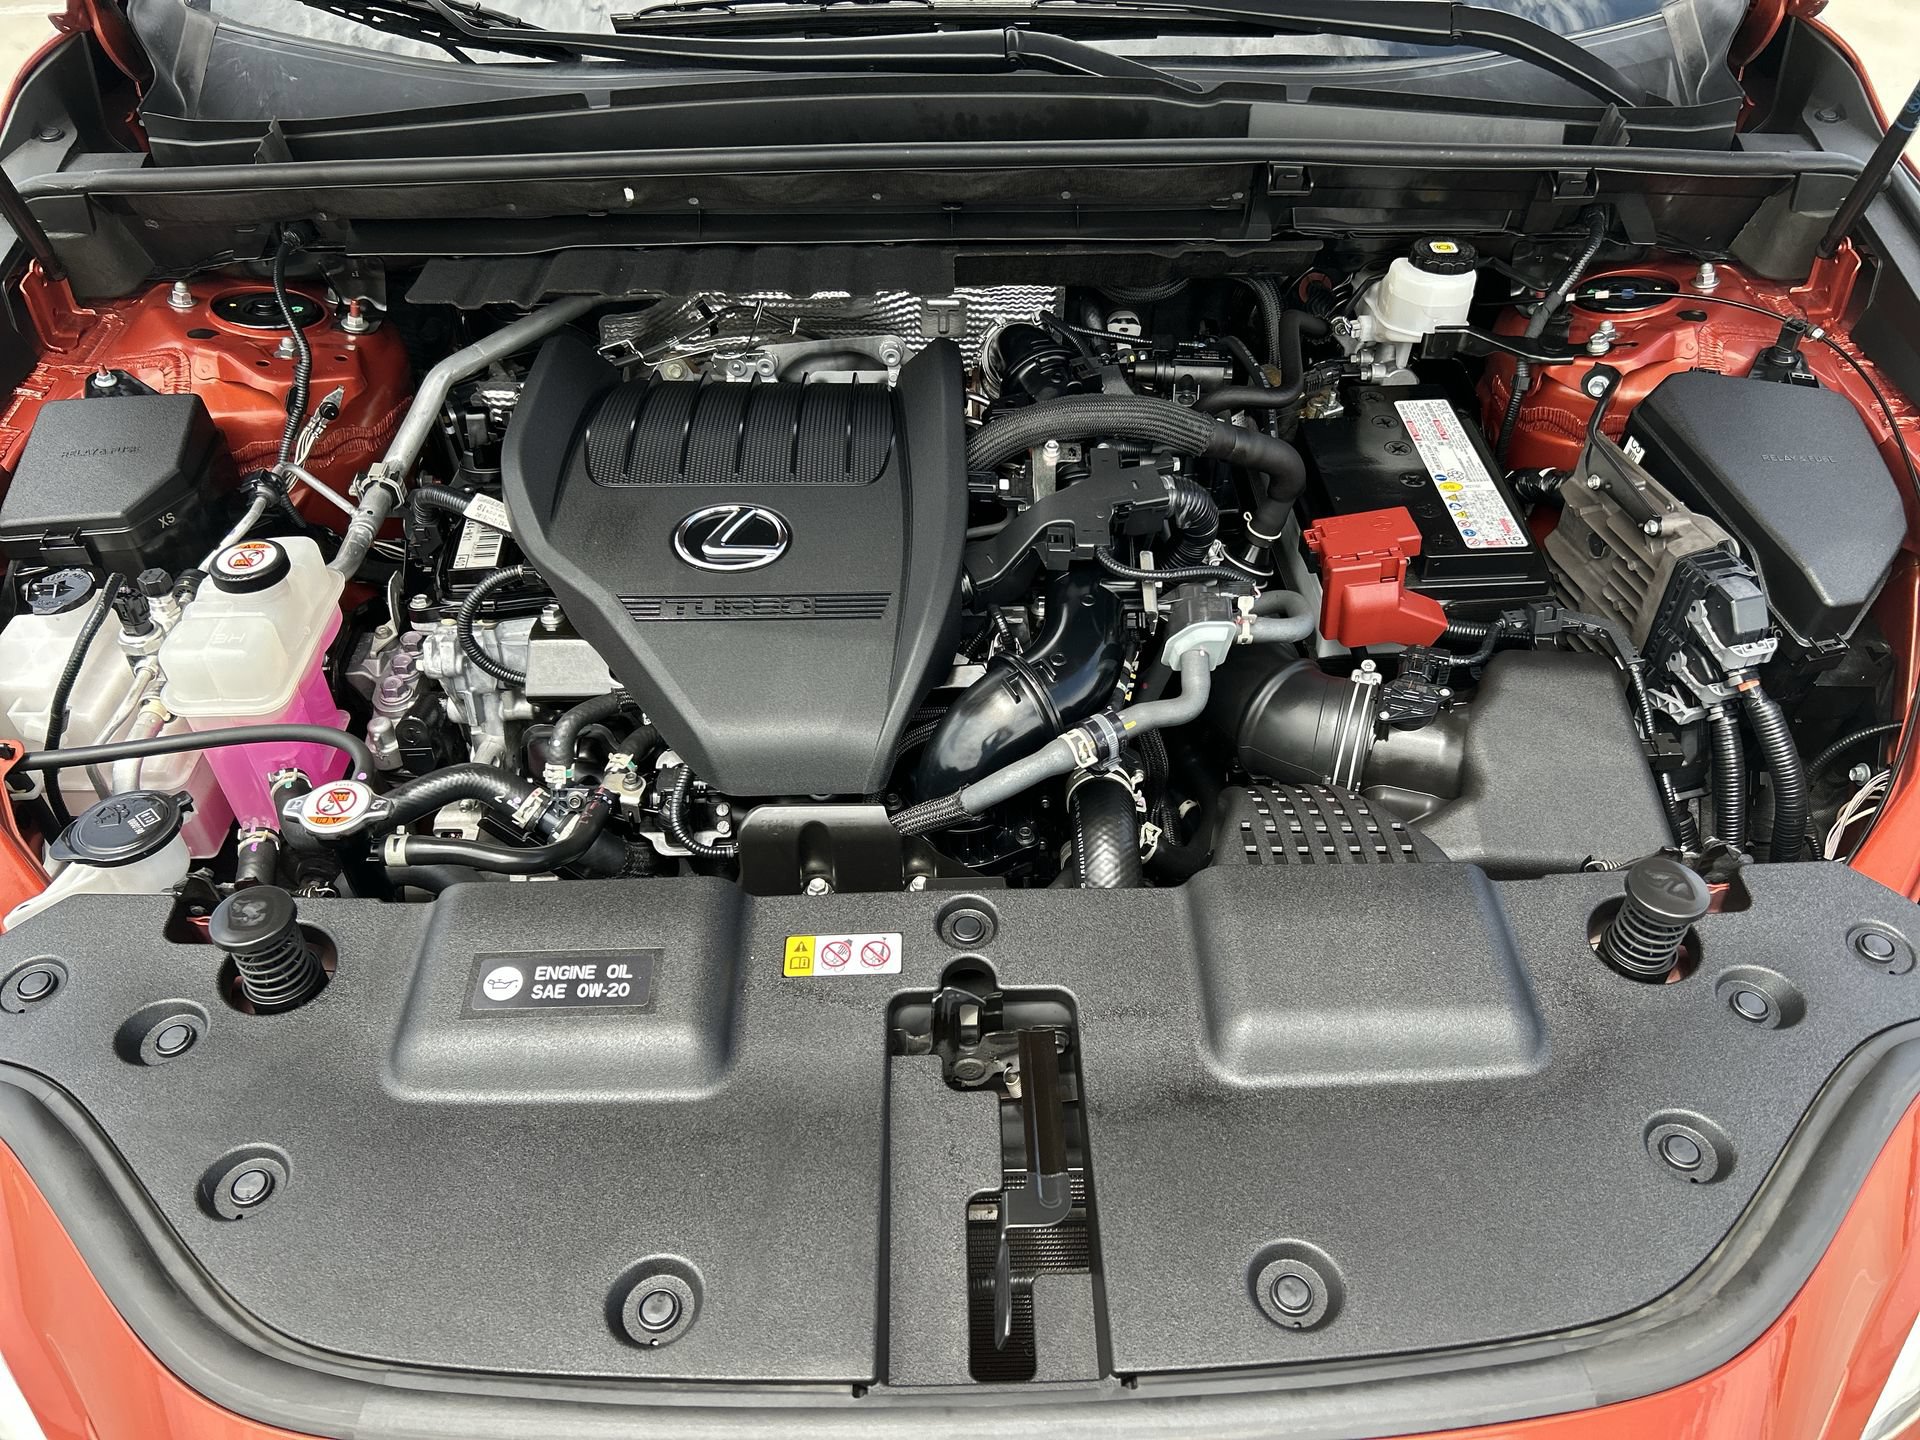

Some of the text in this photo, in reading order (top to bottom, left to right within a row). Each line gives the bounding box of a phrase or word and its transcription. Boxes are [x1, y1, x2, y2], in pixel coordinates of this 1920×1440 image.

[1760, 454, 1796, 462] RELAY
[665, 596, 813, 617] TURBO
[534, 964, 633, 981] ENGINE OIL
[530, 982, 631, 999] SAE 0W-20
